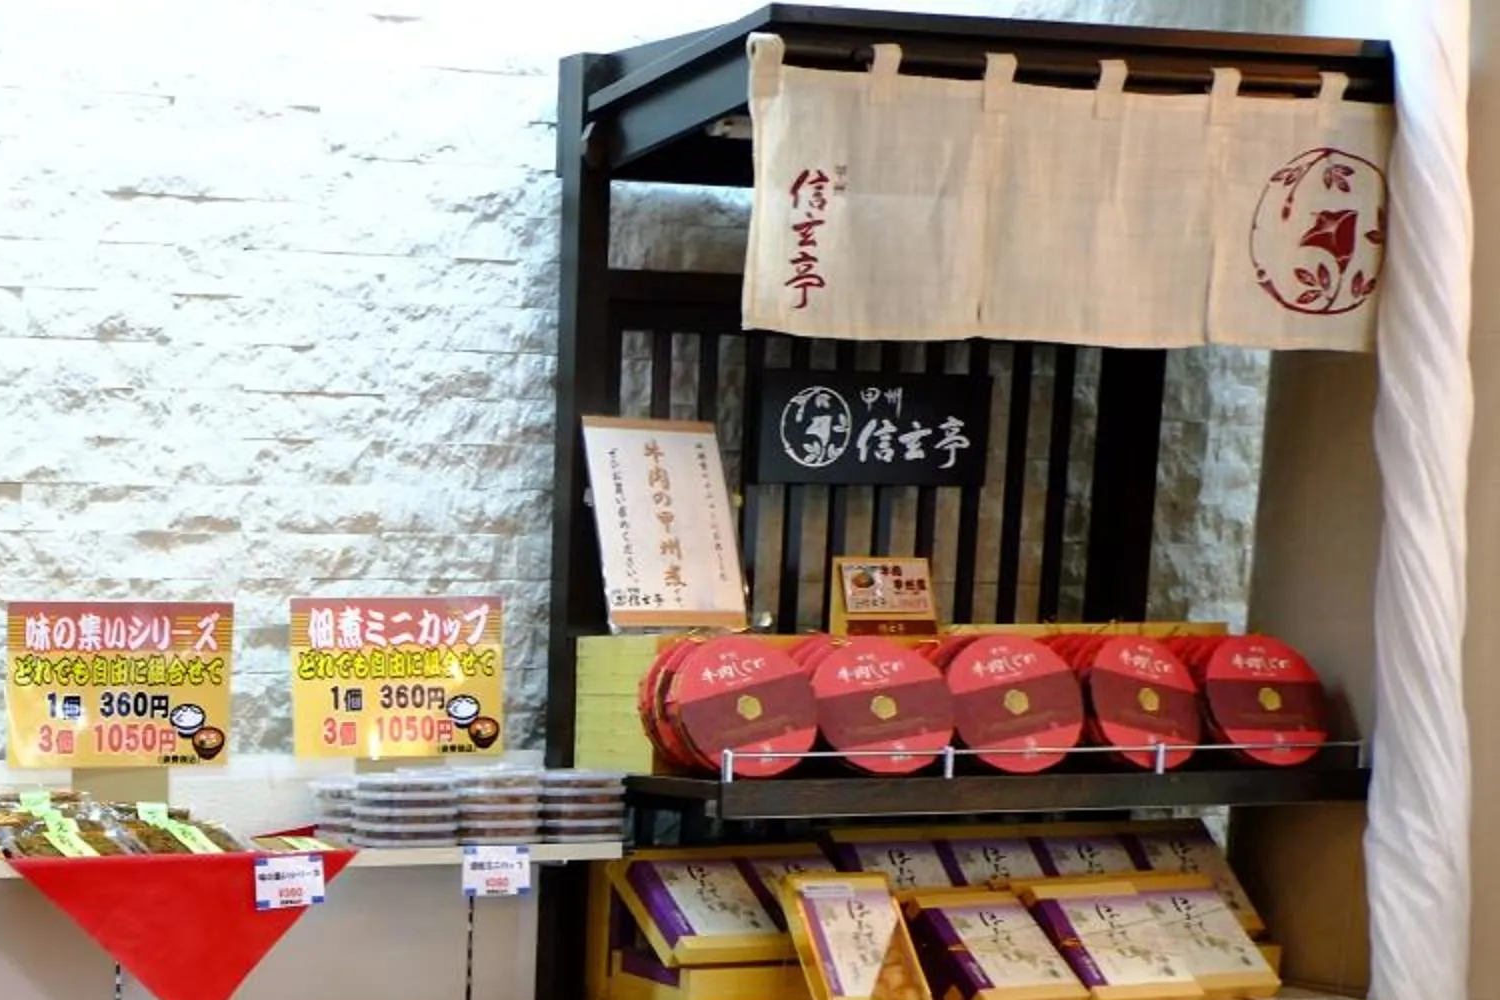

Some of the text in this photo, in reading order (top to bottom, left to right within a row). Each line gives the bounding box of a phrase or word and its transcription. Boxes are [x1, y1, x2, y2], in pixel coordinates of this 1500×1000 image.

[784, 170, 829, 308] 信玄亭
[860, 387, 903, 418] 甲州
[857, 416, 970, 469] 信玄亭
[25, 612, 221, 651] 味の集いシリーズ
[308, 604, 490, 649] 佃煮ミニカップ
[14, 655, 225, 688] どれでも自由に組合せて
[299, 649, 496, 681] どれでも自由に組合せて
[100, 692, 169, 719] 360円
[331, 684, 445, 712] 1個 360円
[38, 723, 177, 754] 3個 1050円
[323, 716, 454, 746] 3個 1050円
